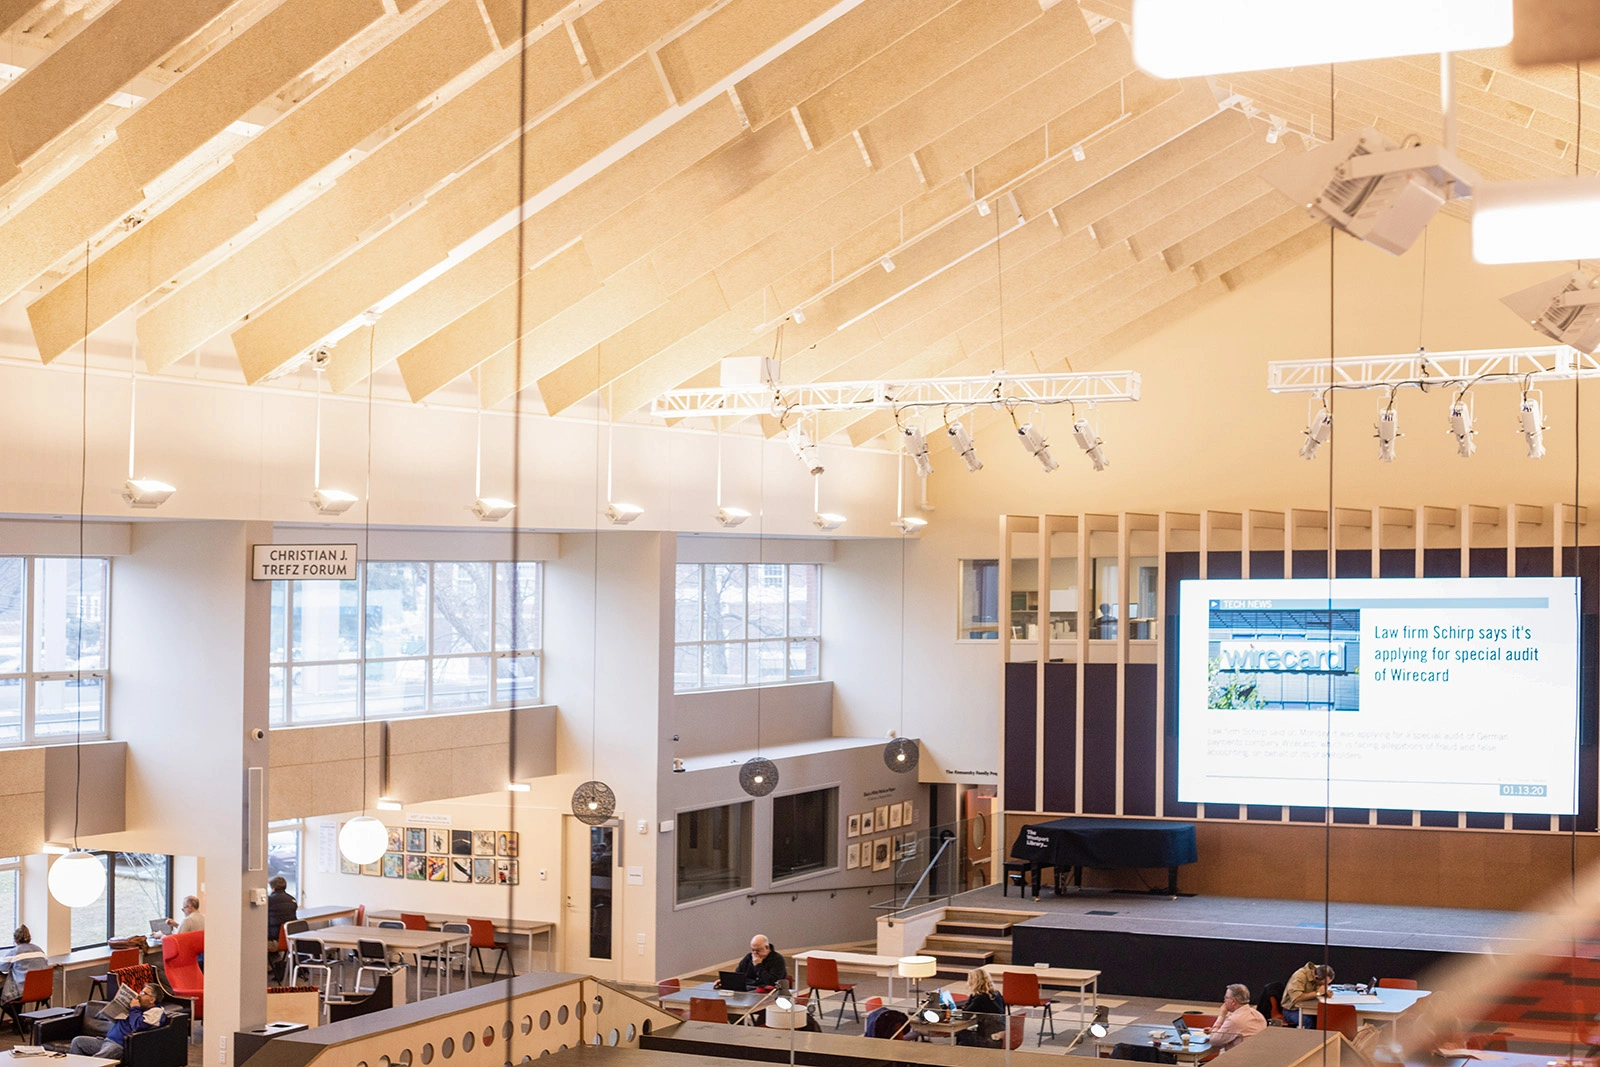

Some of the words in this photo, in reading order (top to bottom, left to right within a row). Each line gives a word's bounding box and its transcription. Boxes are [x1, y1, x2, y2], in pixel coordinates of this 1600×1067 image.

[269, 550, 337, 561] CHRISTIAN
[340, 550, 348, 561] J.
[262, 564, 299, 575] TREFZ
[303, 564, 347, 575] FORUM
[1223, 600, 1246, 609] TECH
[1247, 600, 1273, 609] NEWS
[1374, 625, 1399, 639] Law
[1403, 625, 1429, 639] firm
[1433, 625, 1475, 642] Schirp
[1478, 627, 1508, 642] says
[1511, 625, 1532, 640] it's
[1223, 643, 1344, 670] wirecard
[1374, 647, 1428, 663] applying
[1432, 647, 1451, 661] for
[1455, 647, 1501, 663] special
[1505, 647, 1539, 662] audit
[1374, 668, 1387, 682] of
[1390, 668, 1450, 682] Wirecard
[1502, 785, 1545, 796] 01.13.20
